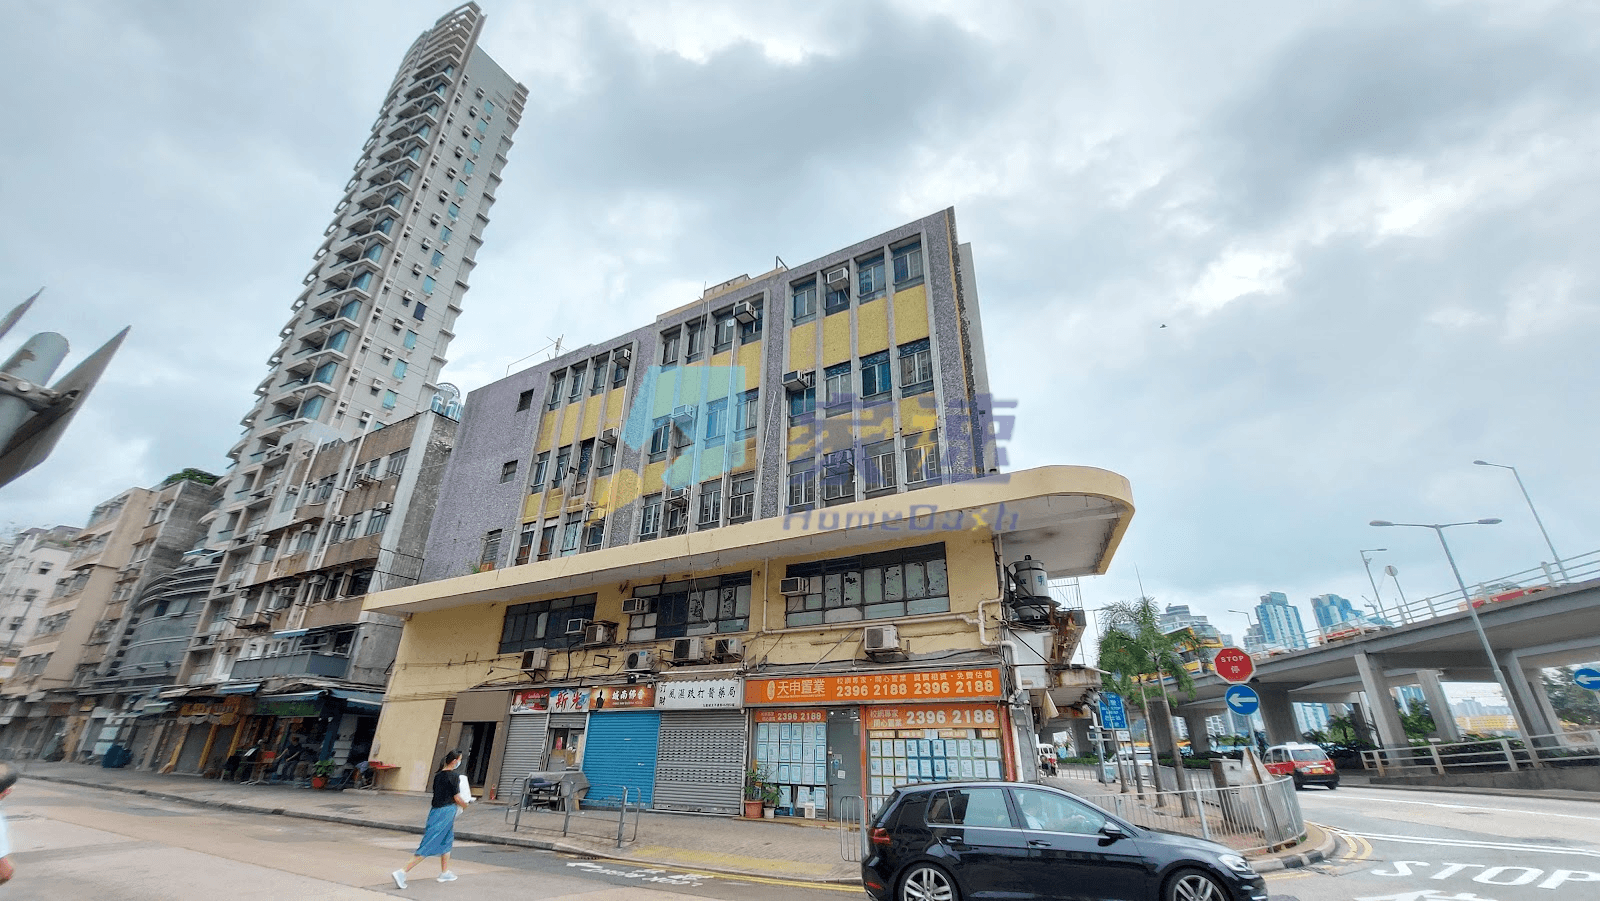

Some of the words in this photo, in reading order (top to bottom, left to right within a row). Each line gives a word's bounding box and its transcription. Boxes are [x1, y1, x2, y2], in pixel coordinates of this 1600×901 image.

[1220, 655, 1244, 663] STOP
[1230, 665, 1240, 674] 停
[777, 678, 825, 696] 天申置業
[836, 684, 868, 697] 2396
[874, 683, 907, 696] 2188
[914, 681, 950, 695] 2396
[955, 679, 994, 693] 2188
[556, 691, 584, 710] 新光
[777, 712, 797, 721] 2396
[800, 712, 822, 721] 2188
[906, 710, 946, 725] 2396
[951, 709, 995, 724] 2188
[1371, 860, 1600, 890] STOP
